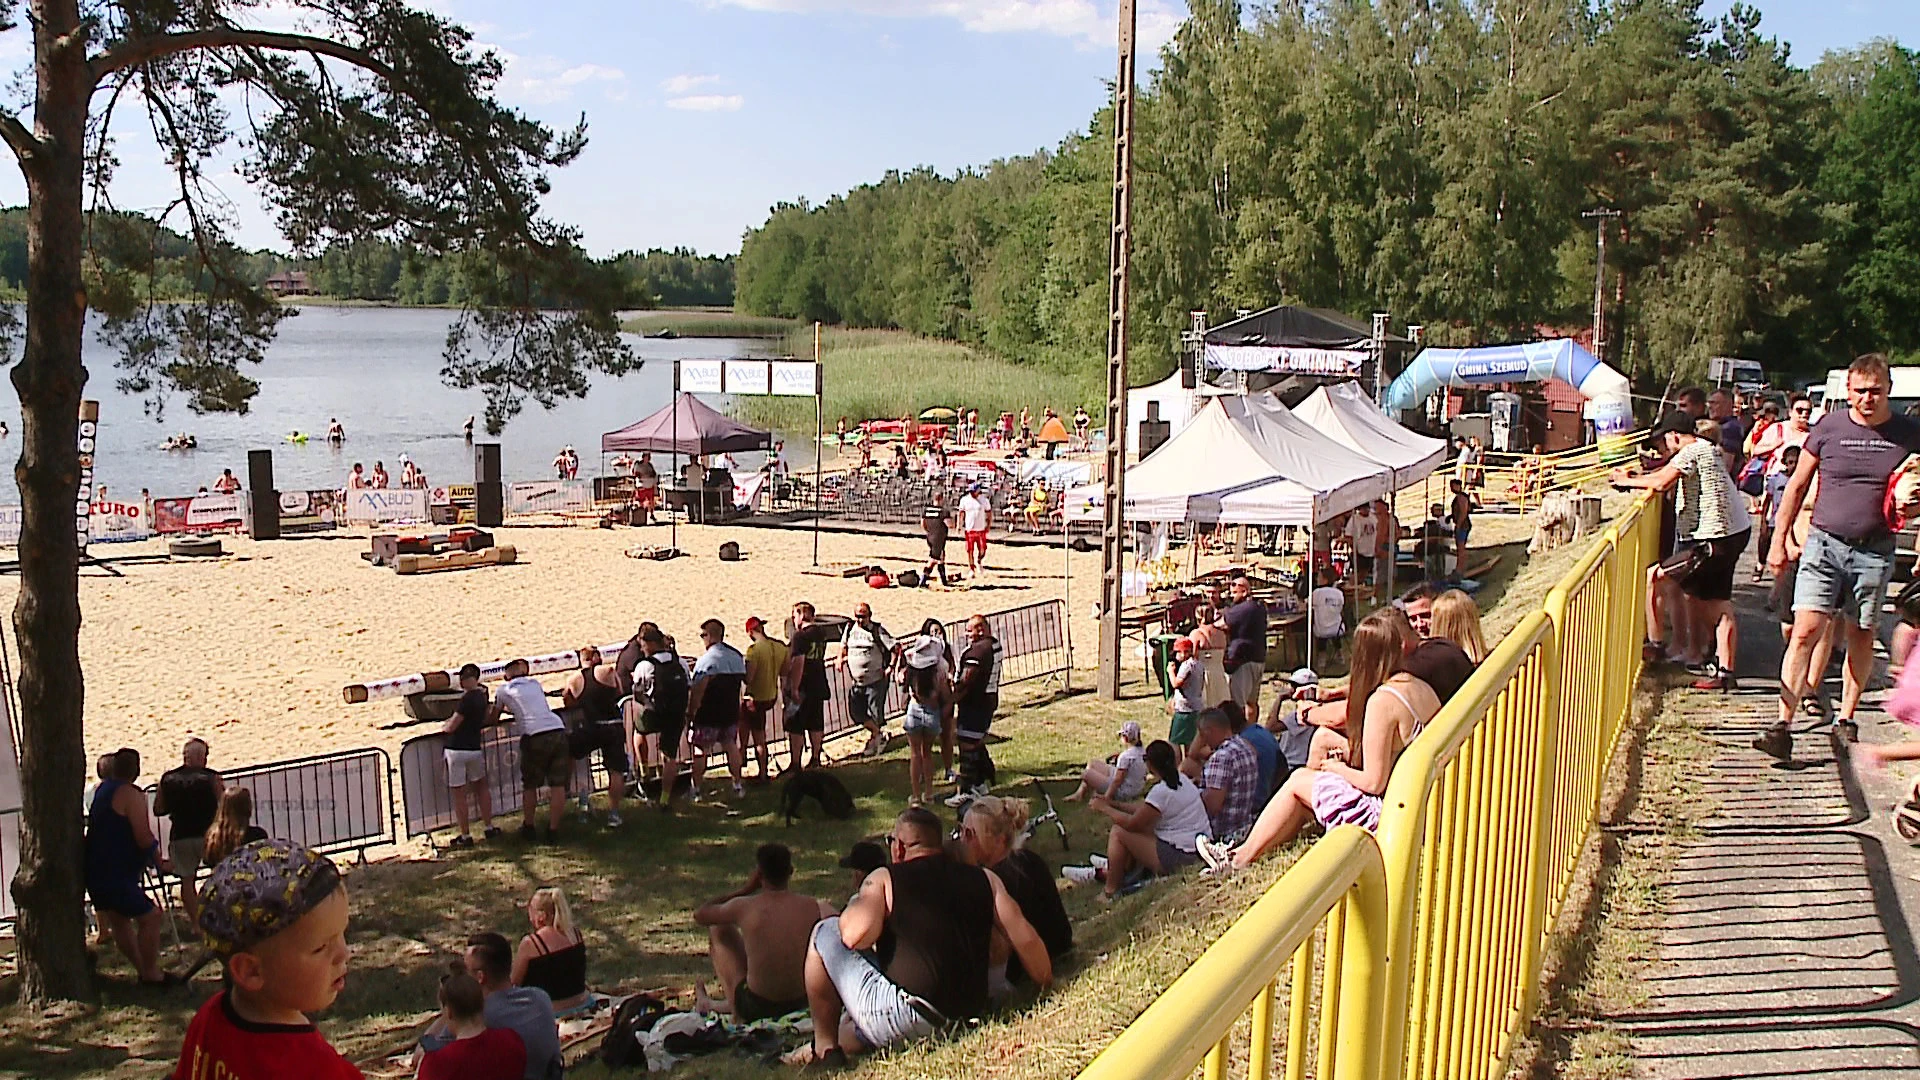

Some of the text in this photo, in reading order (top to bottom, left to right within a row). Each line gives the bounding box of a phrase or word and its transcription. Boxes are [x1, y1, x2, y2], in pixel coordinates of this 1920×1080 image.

[1290, 351, 1345, 371] GMINNE
[1458, 360, 1528, 376] GMINA SZEMUD
[451, 487, 475, 497] AUTO
